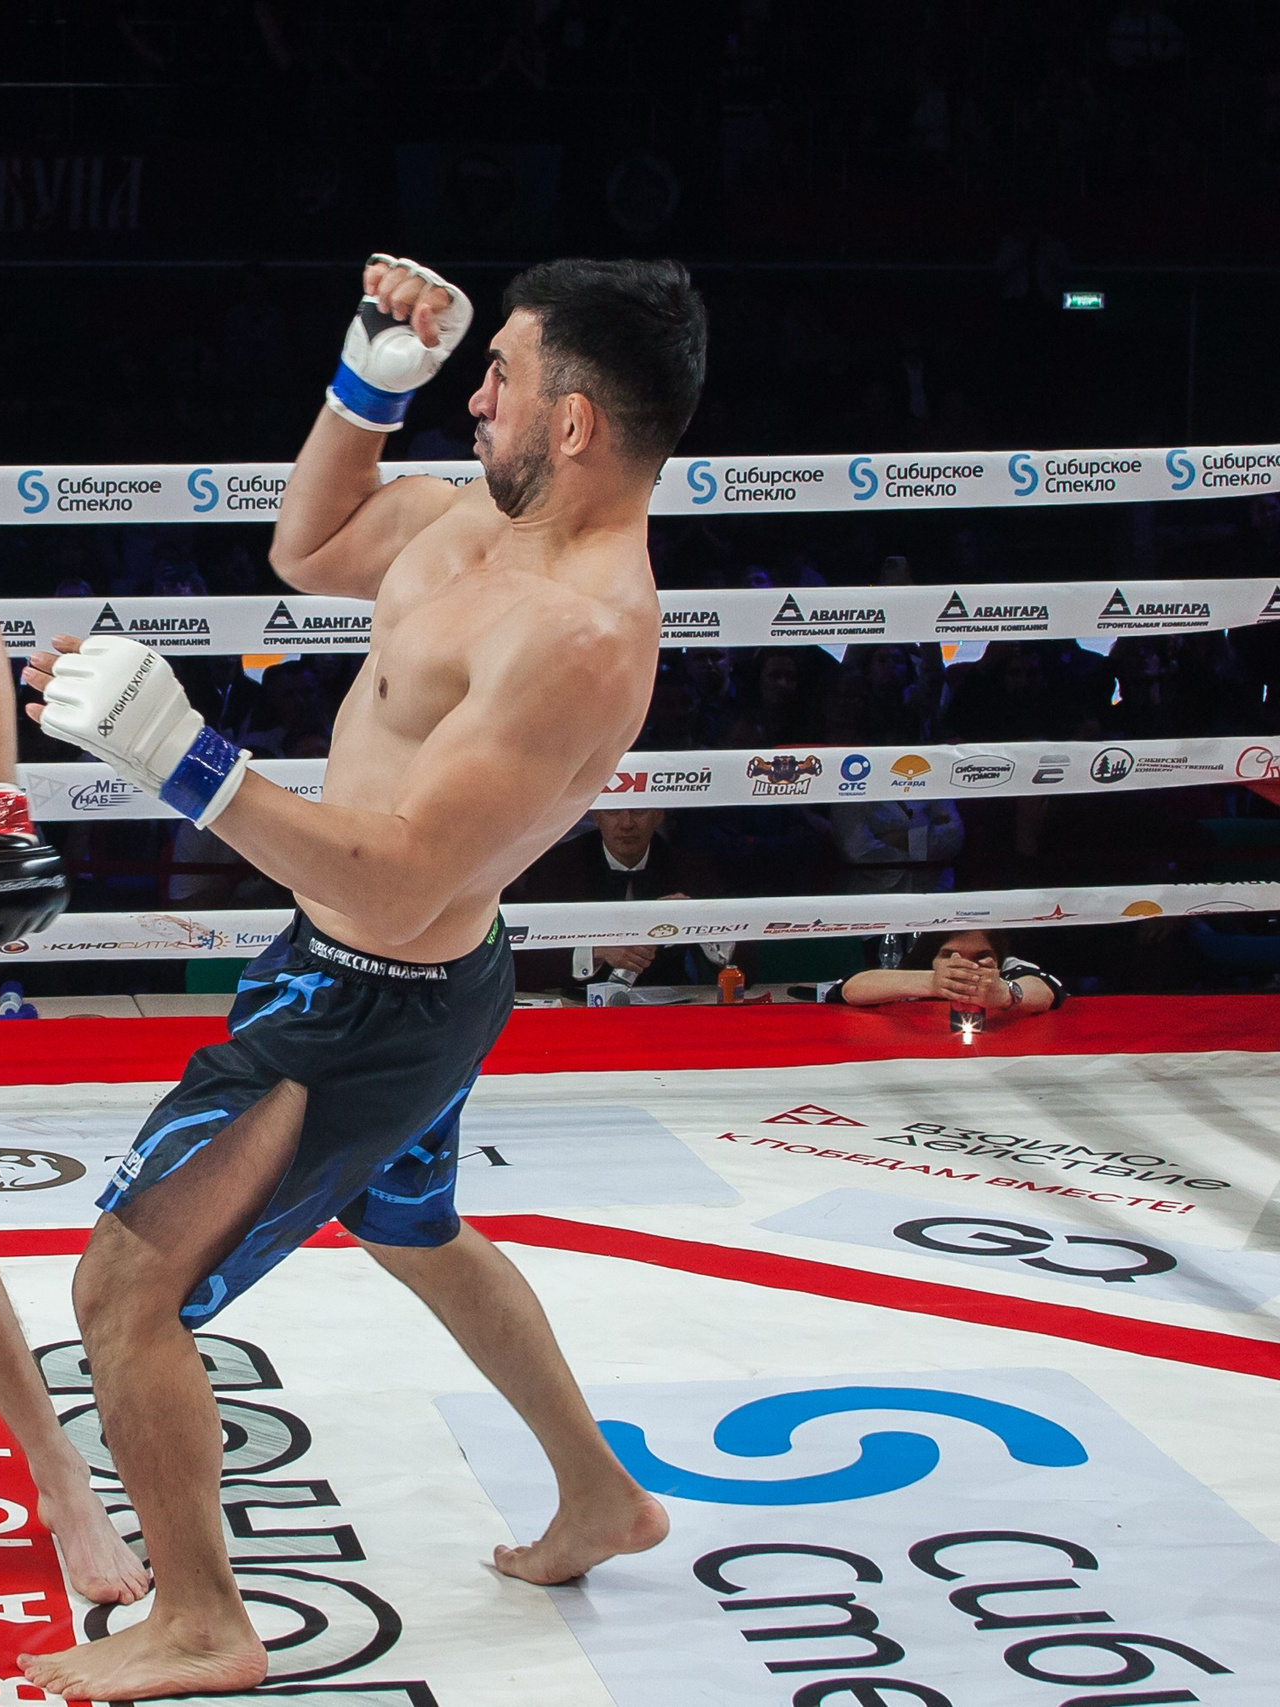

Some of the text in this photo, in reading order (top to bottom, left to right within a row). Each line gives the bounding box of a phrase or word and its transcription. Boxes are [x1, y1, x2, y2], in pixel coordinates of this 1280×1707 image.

[885, 463, 984, 482] Сибирское
[1045, 458, 1143, 477] Сибирское
[724, 468, 825, 486] Сибирское
[1044, 476, 1116, 493] Стекло
[1202, 471, 1272, 487] Стекло
[58, 477, 162, 496] Сибирское
[227, 475, 287, 495] Сибир
[885, 481, 957, 498] Стекло
[724, 485, 797, 502] Стекло
[57, 496, 133, 512] Стекло
[226, 494, 283, 510] Стек
[809, 609, 886, 623] АВАНГАРД
[973, 605, 1049, 619] АВАНГАРД
[1136, 602, 1211, 617] АВАНГАРД
[129, 618, 210, 634] АВАНГАРД
[302, 617, 373, 631] АВАНГАР
[662, 611, 720, 626] АНГАРД
[671, 630, 720, 638] КОМПАНИЯ
[771, 627, 885, 637] СТРОИТЕЛЬНАЯ КОМПАНИЯ
[935, 623, 1048, 633] СТРОИТЕЛЬНАЯ КОМПАНИЯ
[160, 638, 210, 646] КОМПАНИЯ
[263, 636, 370, 645] СТРОИТЕЛЬНАЯ КОМПАН
[109, 653, 157, 724] FIGHTEXPERT
[1138, 756, 1188, 764] СИБИРСКИЙ
[652, 766, 712, 783] СТРОЙ
[955, 763, 1011, 774] сибирский
[891, 778, 926, 788] Асгард
[962, 771, 1000, 782] гурман
[651, 784, 711, 792] КОМПЛЕКТ
[752, 777, 812, 796] ШТОРМ
[838, 782, 867, 791] ОТС
[531, 932, 640, 942] Недвижимость
[716, 1132, 1197, 1214] К ПОБЕДАМ ВМЕСТЕ!
